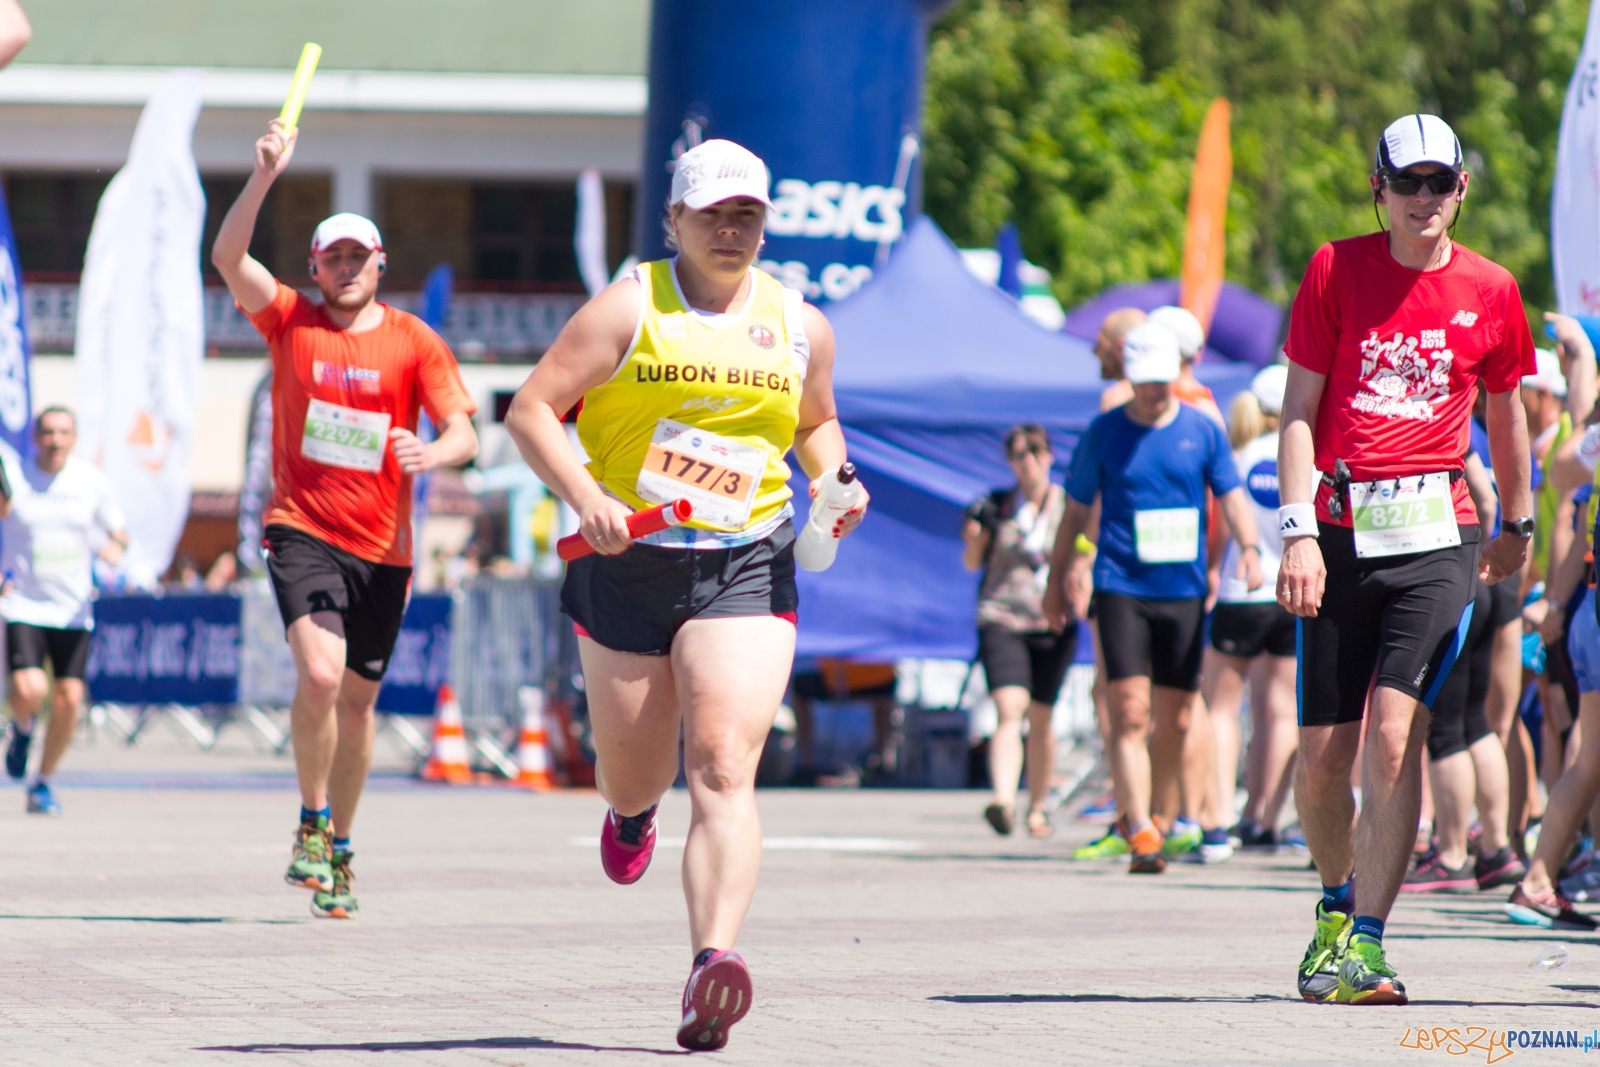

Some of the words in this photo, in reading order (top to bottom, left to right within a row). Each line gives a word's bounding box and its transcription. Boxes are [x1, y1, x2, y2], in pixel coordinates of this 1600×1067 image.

[766, 178, 906, 243] asics
[1420, 329, 1446, 340] 1966
[1420, 338, 1446, 349] 2016
[636, 362, 716, 383] LUBOŃ
[727, 367, 790, 395] BIEGA
[312, 421, 372, 448] 229/2
[661, 450, 741, 494] 177/3
[1371, 501, 1429, 528] 82/2
[1413, 662, 1430, 687] ACTIVE
